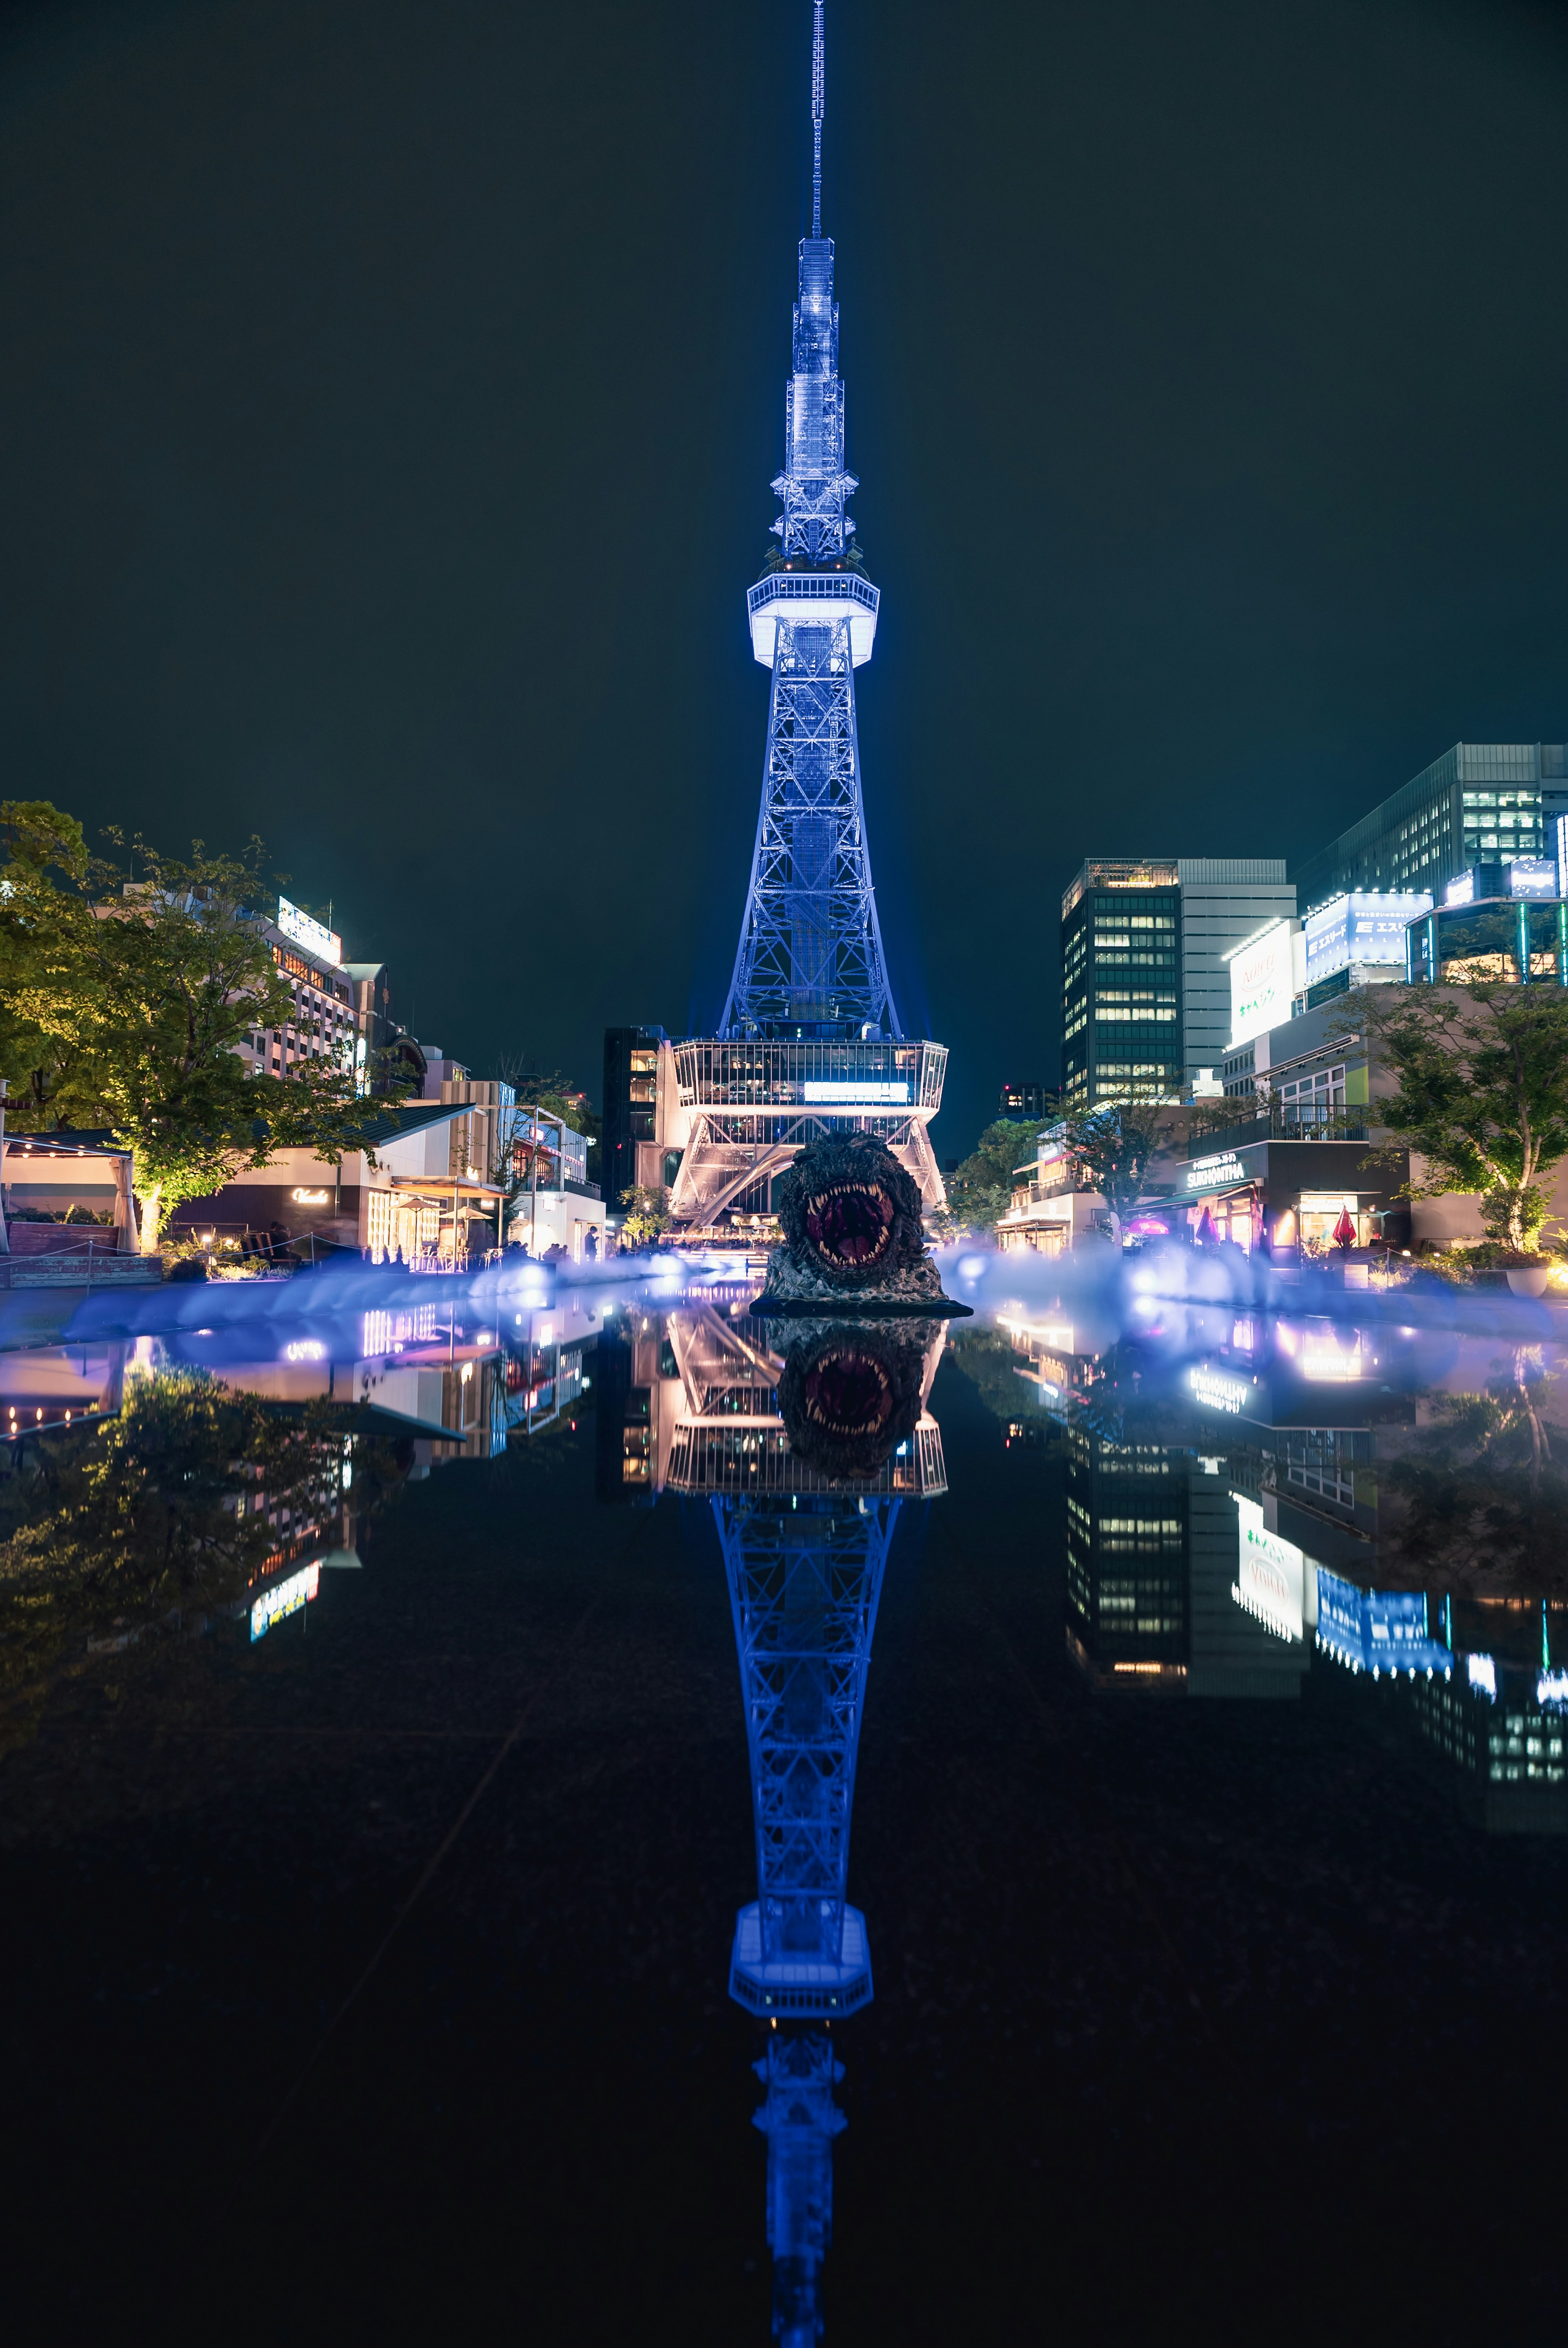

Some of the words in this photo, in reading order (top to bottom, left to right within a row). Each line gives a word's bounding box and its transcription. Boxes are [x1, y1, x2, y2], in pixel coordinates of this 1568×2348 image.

[1319, 923, 1347, 950] エスリード
[1187, 1162, 1244, 1188] SUKHONTHA
